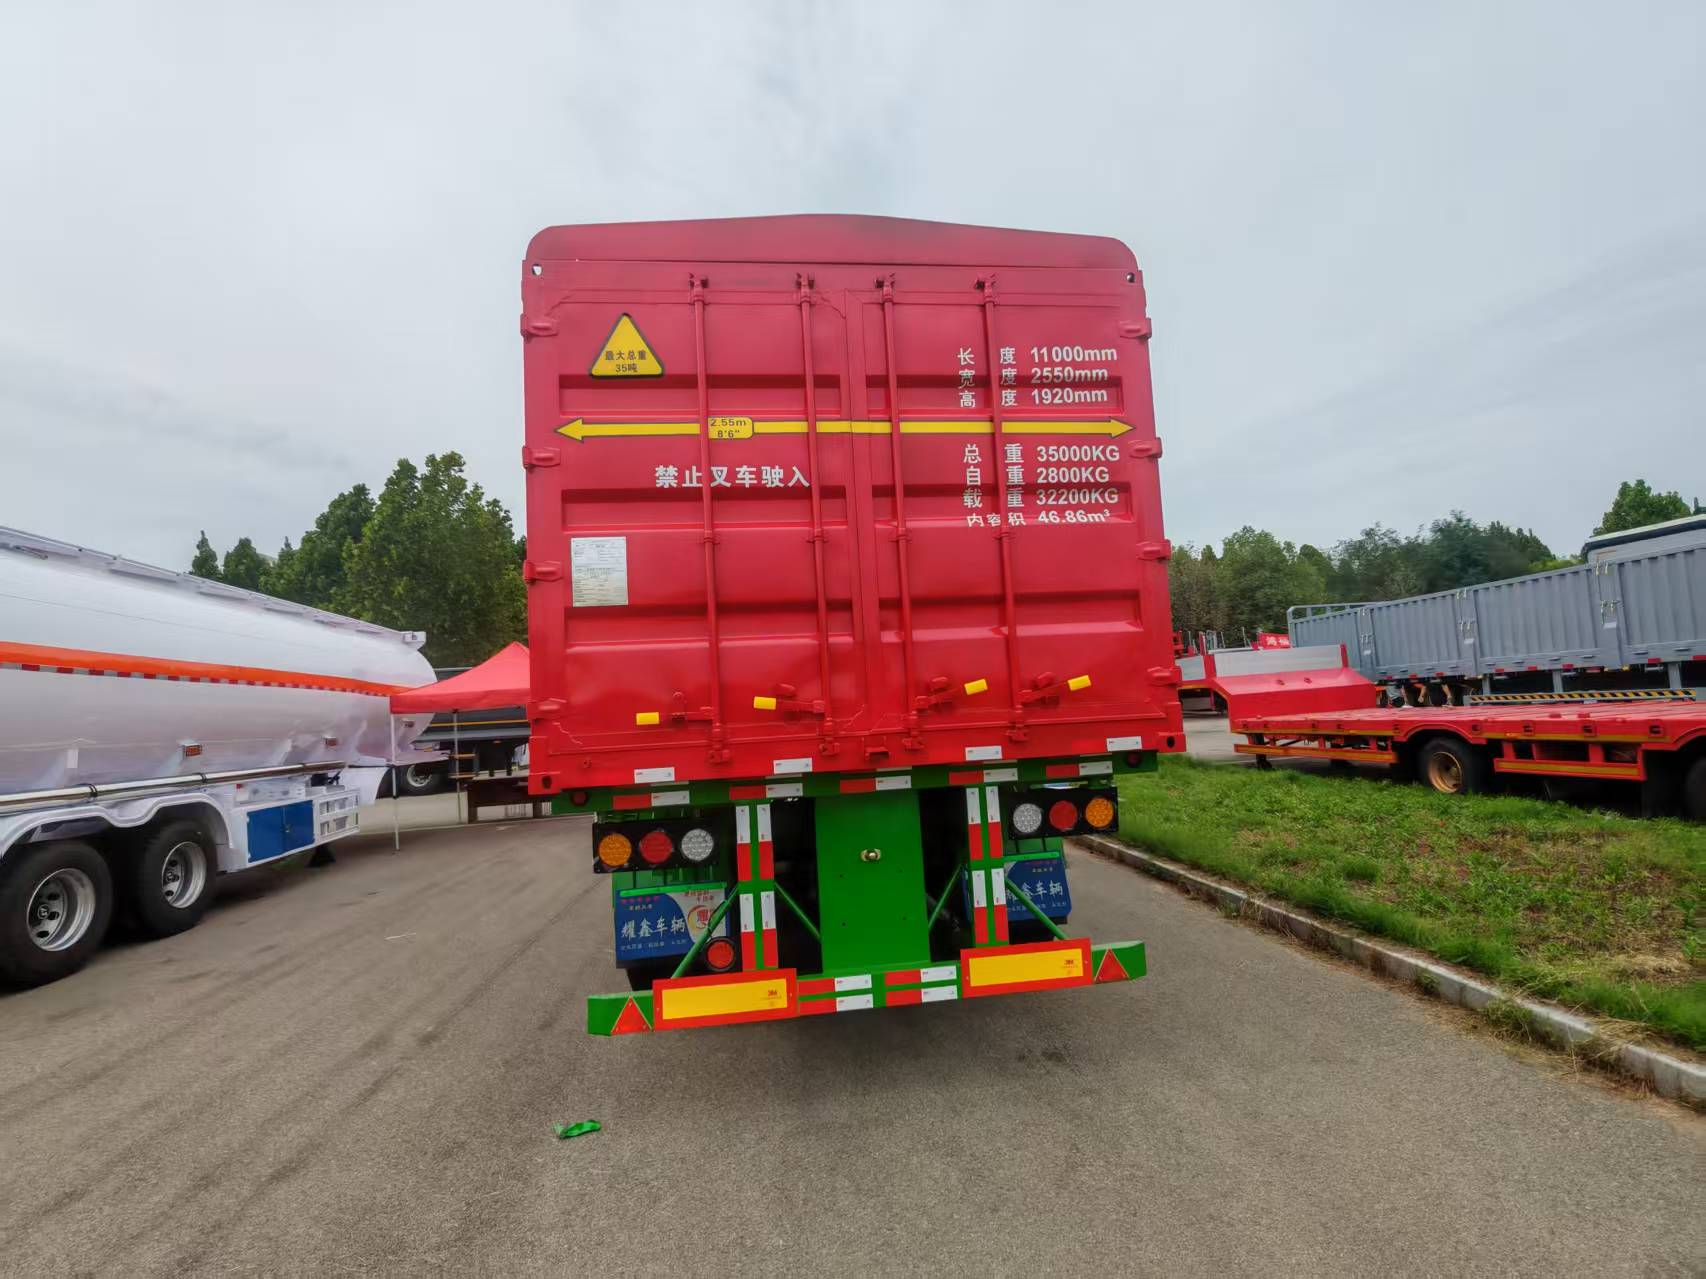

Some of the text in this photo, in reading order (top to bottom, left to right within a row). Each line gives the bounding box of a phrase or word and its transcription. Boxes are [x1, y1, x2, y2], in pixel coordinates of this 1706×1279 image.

[604, 350, 647, 361] 最大总重
[1030, 345, 1117, 363] 11000mm
[615, 363, 638, 373] 35吨
[1030, 366, 1108, 384] 2550mm
[1031, 387, 1108, 405] 1920mm
[710, 418, 746, 427] 2.55m
[1036, 445, 1120, 462] 35000KG
[655, 465, 810, 488] 禁止叉车驶入
[1036, 466, 1109, 483] 2800KG
[1036, 487, 1119, 505] 32200KG
